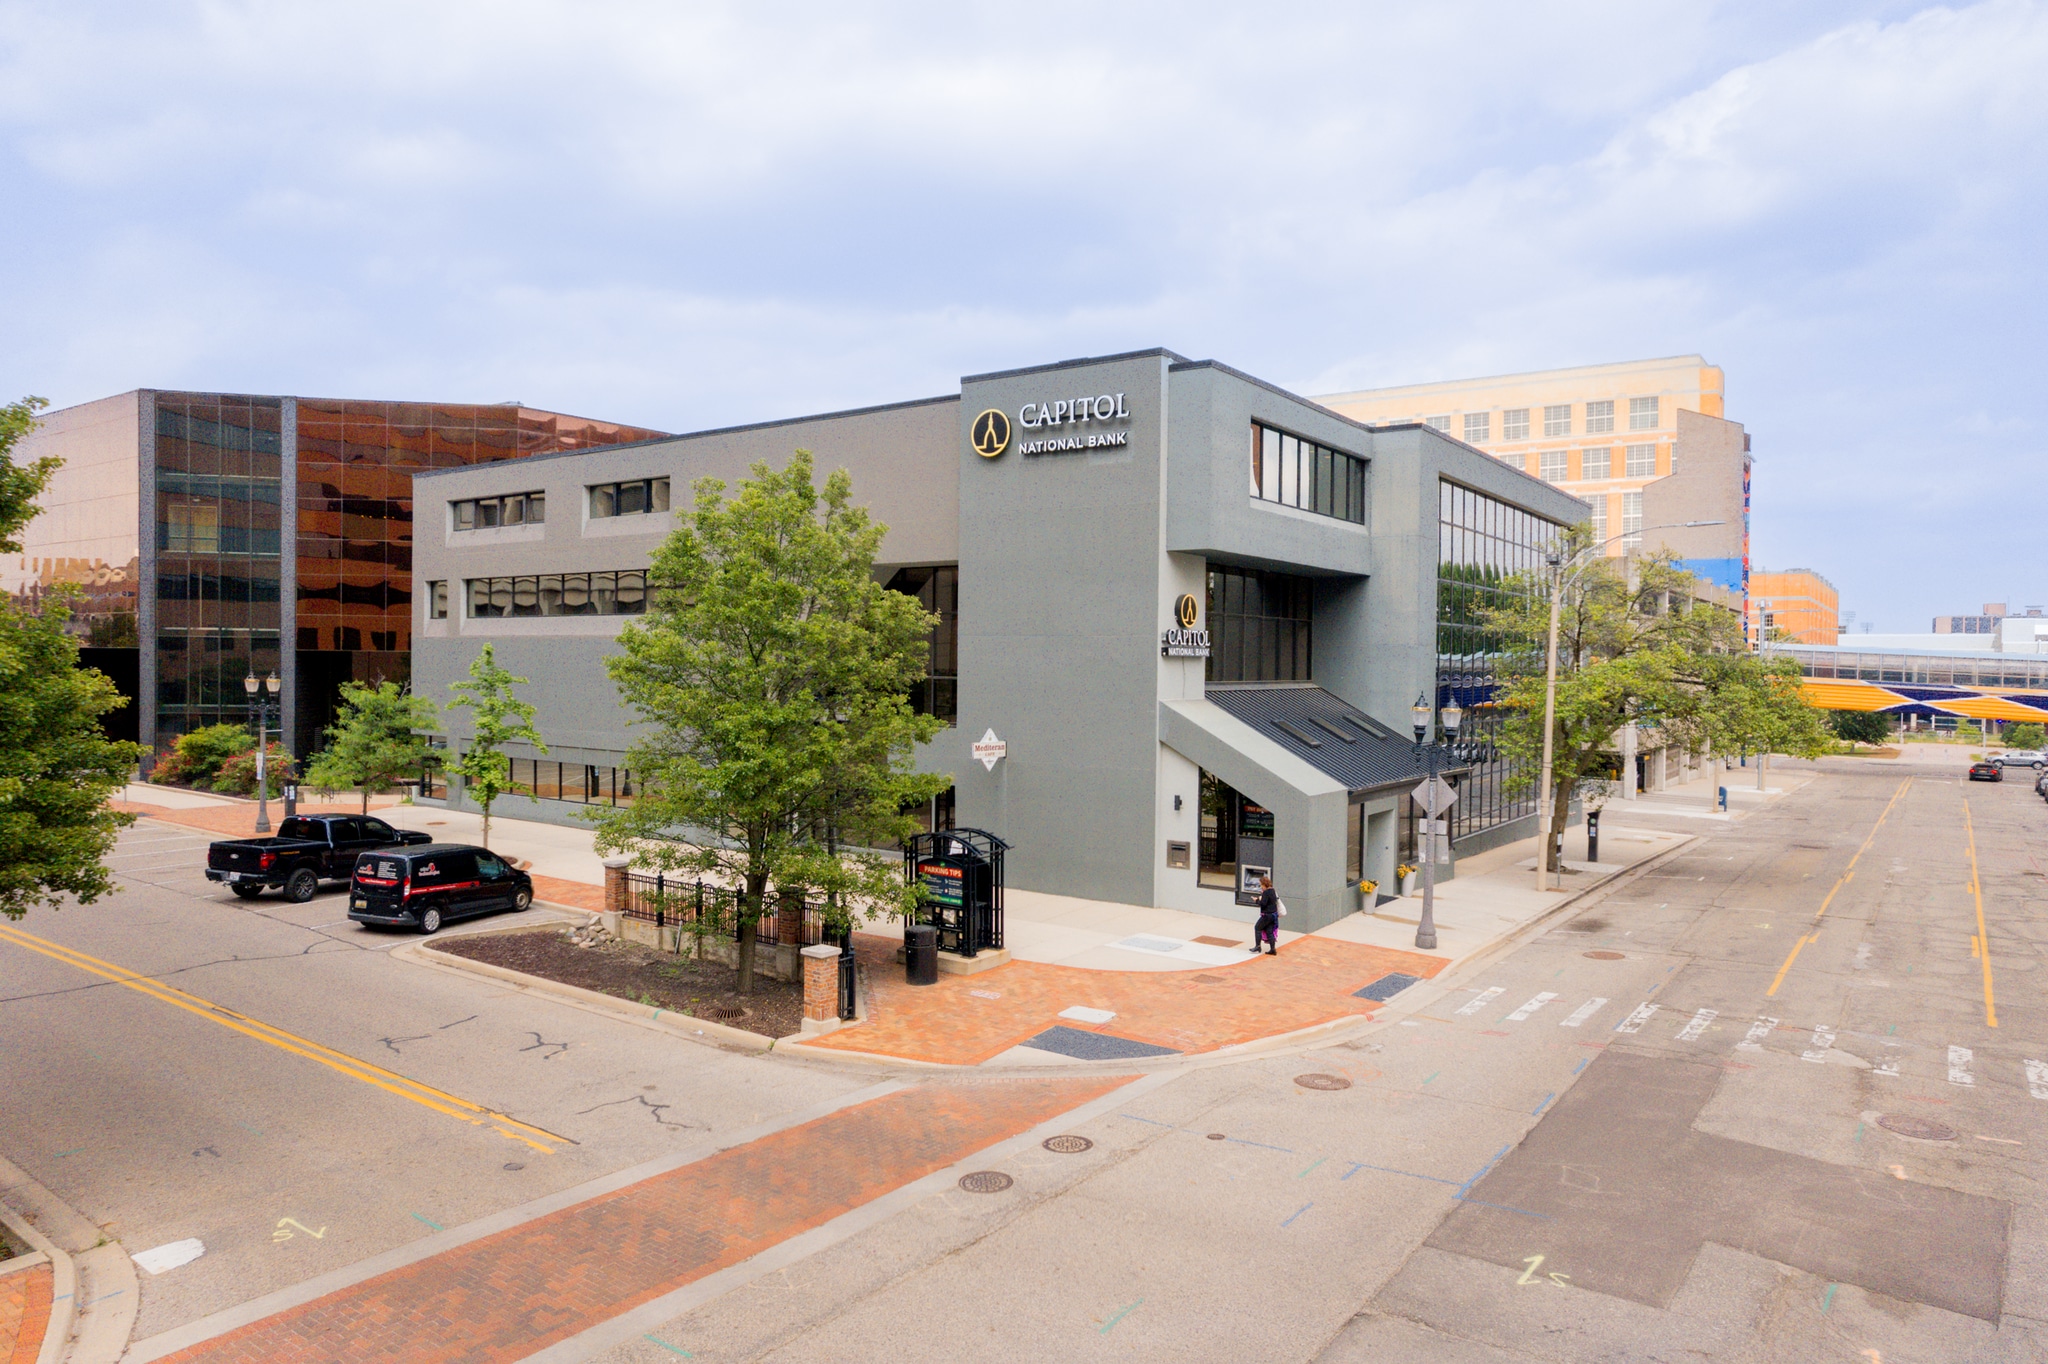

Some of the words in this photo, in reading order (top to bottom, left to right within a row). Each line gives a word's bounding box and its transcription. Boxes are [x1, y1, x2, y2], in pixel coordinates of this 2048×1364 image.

[1019, 393, 1130, 428] CAPITOL
[1019, 437, 1084, 454] NATIONAL
[1088, 432, 1127, 447] BANK
[1168, 629, 1211, 646] CAPITOL
[1168, 648, 1194, 656] NATIONAL
[1196, 648, 1210, 657] BANK
[975, 744, 1005, 752] Mediteran
[924, 866, 949, 877] PARKING
[949, 869, 962, 877] TIPS
